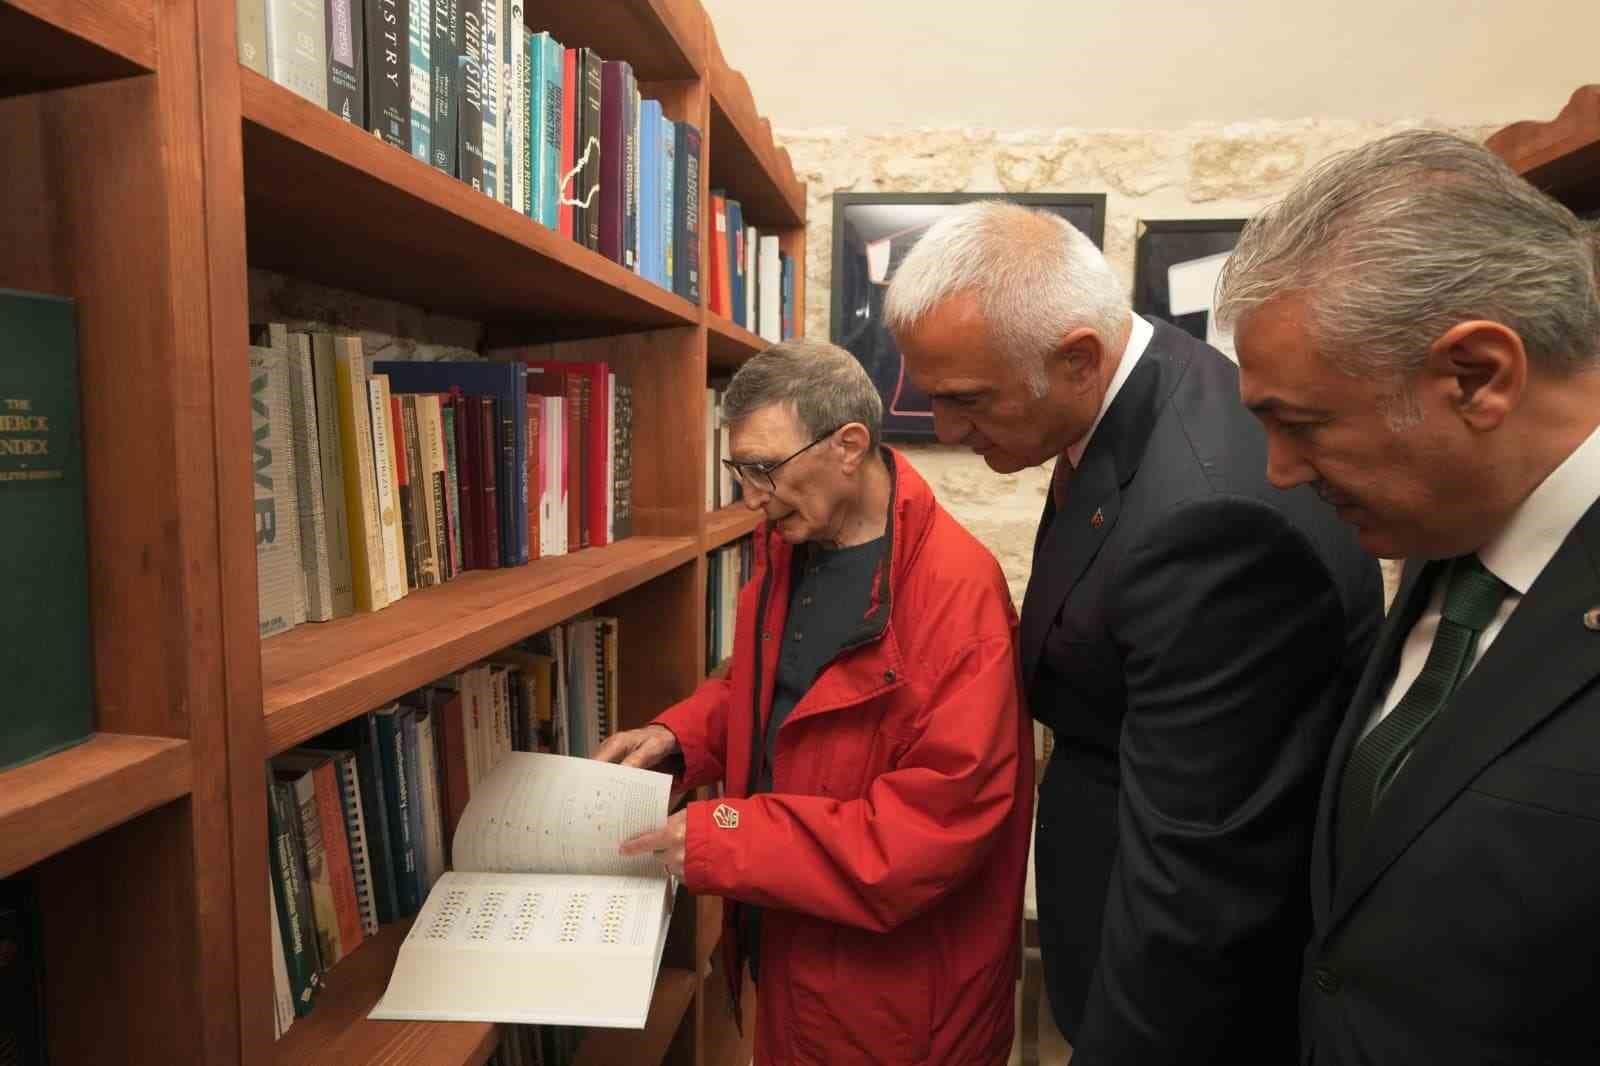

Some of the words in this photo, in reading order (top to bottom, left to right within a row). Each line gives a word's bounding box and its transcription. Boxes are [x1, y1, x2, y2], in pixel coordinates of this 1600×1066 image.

[464, 11, 480, 112] CHEMISTRY
[523, 87, 531, 143] DAMAGE
[251, 373, 276, 545] VWR
